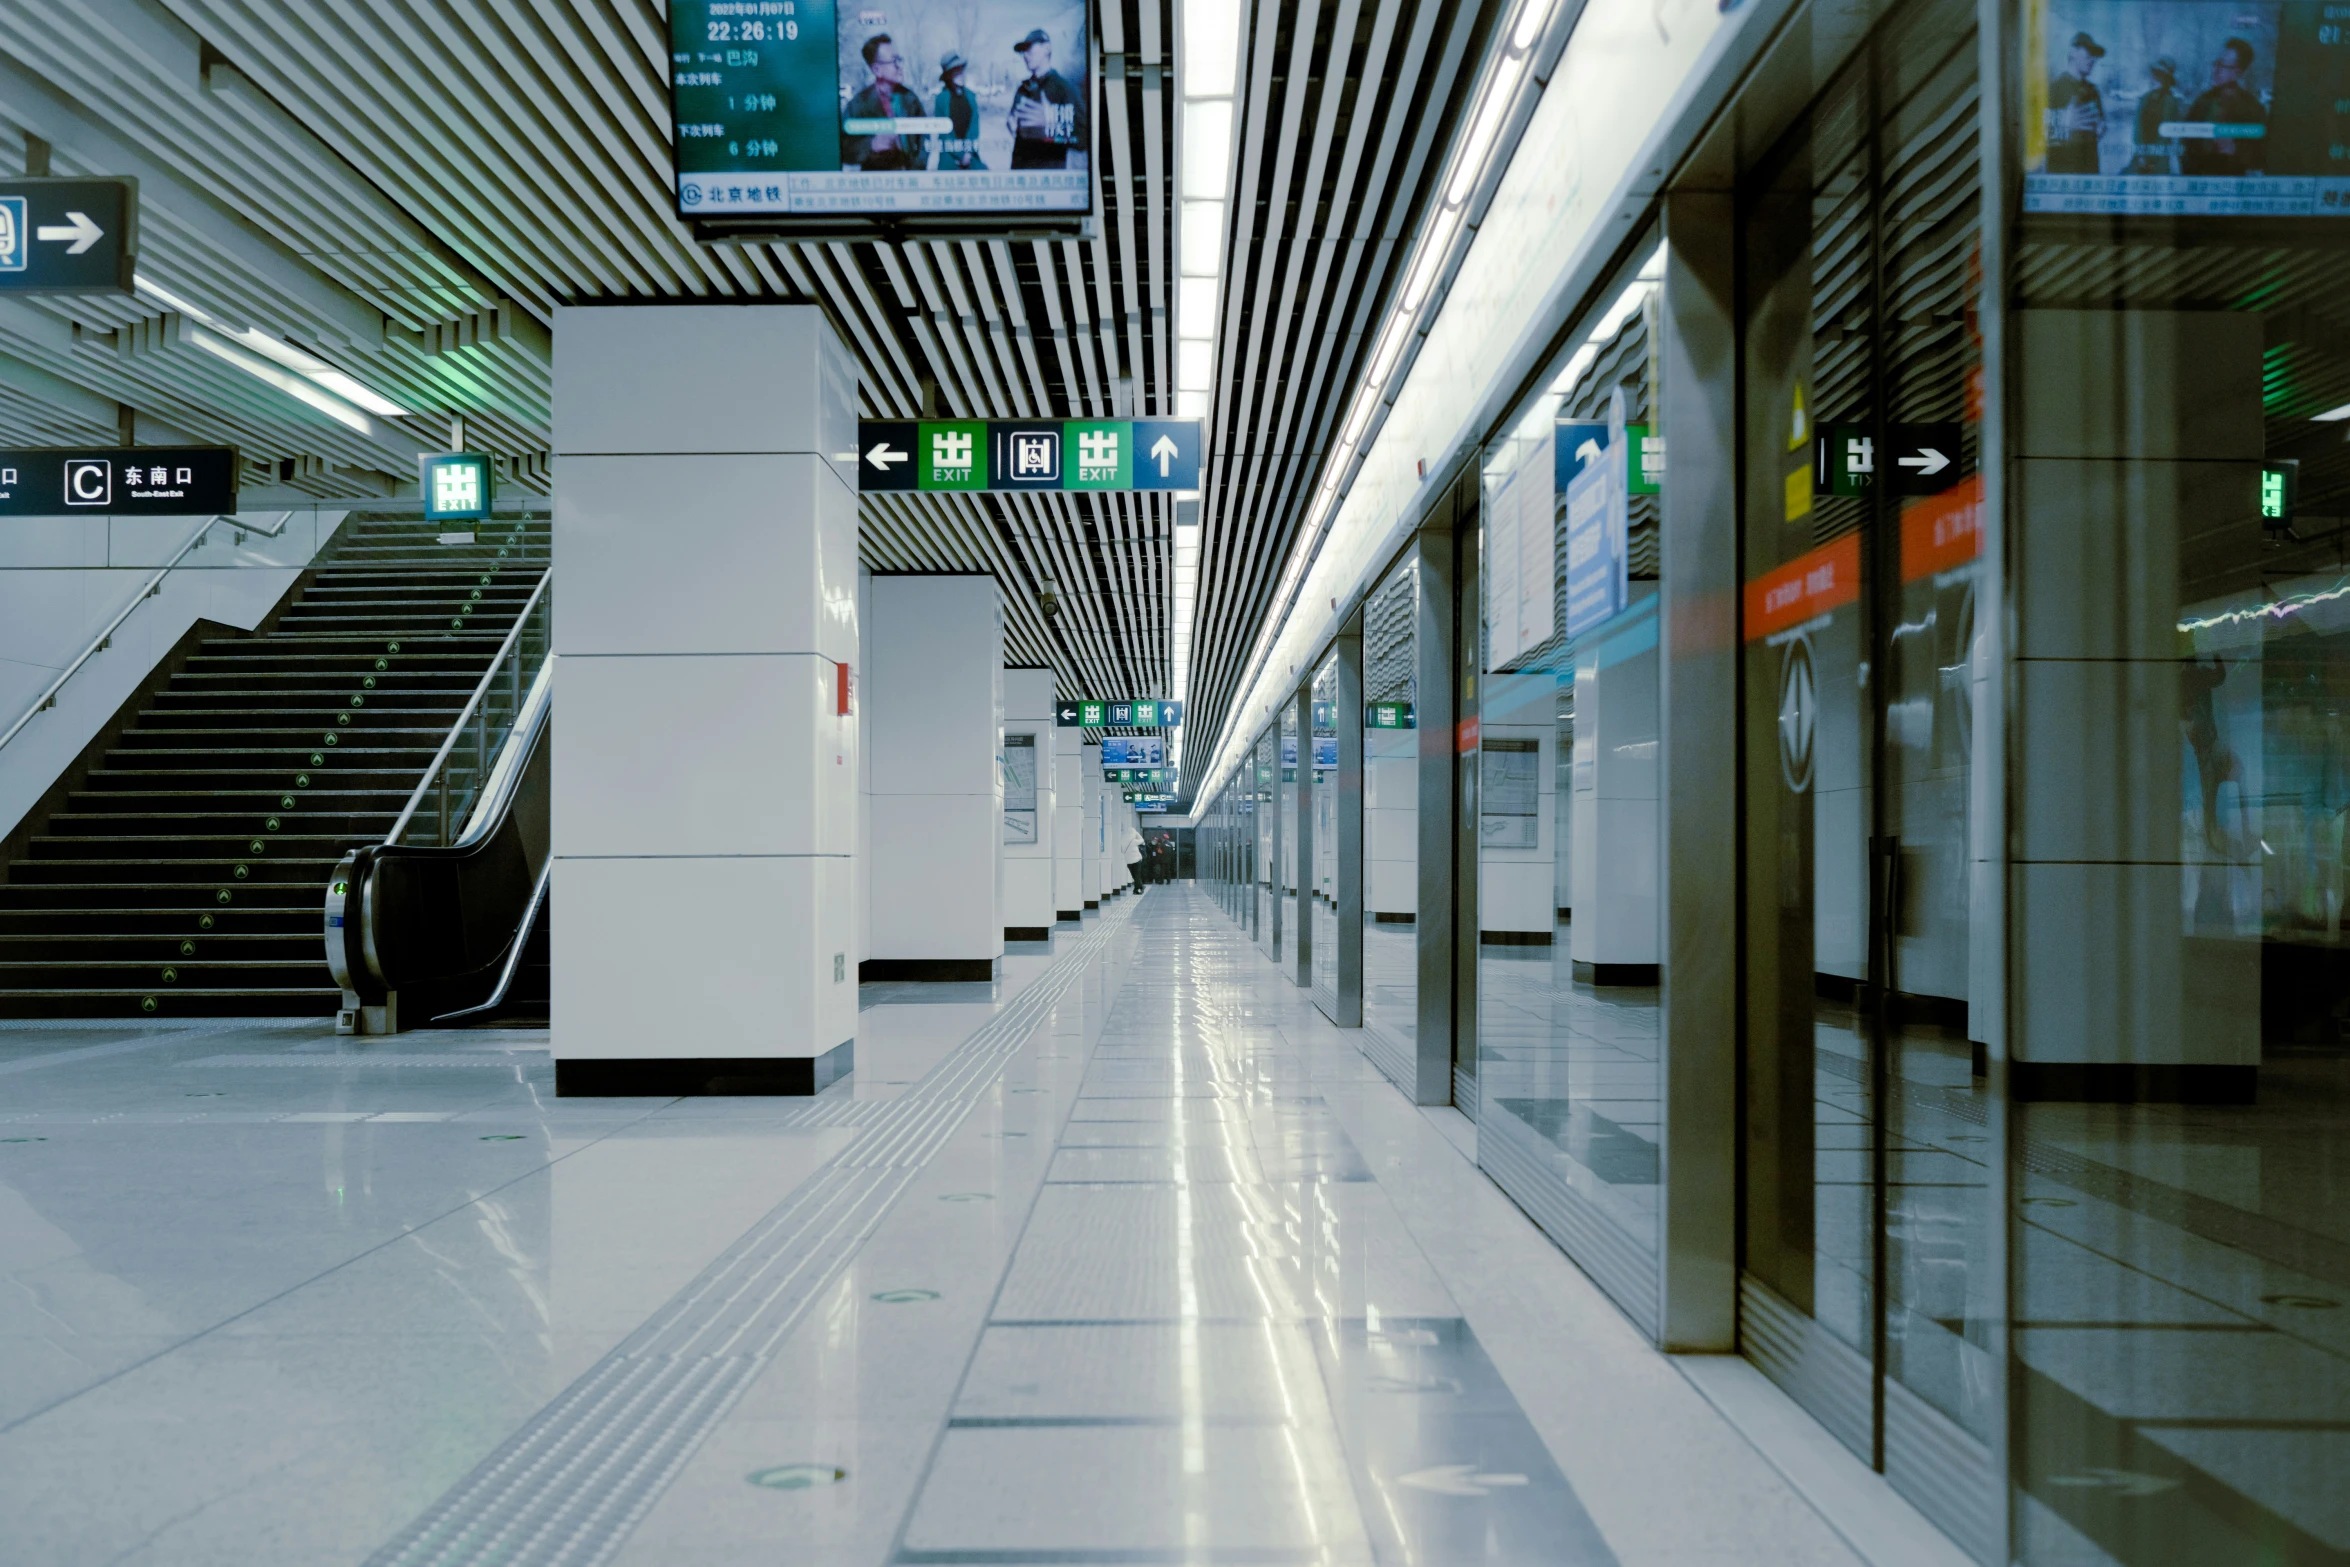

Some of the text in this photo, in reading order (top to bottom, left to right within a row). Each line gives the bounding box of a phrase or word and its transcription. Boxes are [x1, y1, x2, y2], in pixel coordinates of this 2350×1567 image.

[709, 2, 795, 15] 2022年01月07日
[707, 20, 799, 41] 22:26:19
[726, 49, 758, 67] 巴沟
[675, 72, 722, 86] 本次列车
[744, 93, 777, 112] 分钟
[678, 123, 725, 137] 下次列车
[728, 139, 779, 157] 6 分钟
[709, 186, 782, 203] 北京地铁
[933, 469, 972, 481] EXIT
[1079, 468, 1118, 481] EXIT
[73, 465, 104, 499] C
[125, 466, 192, 486] 东南口
[169, 490, 185, 498] Exit
[438, 500, 477, 511] EXIT
